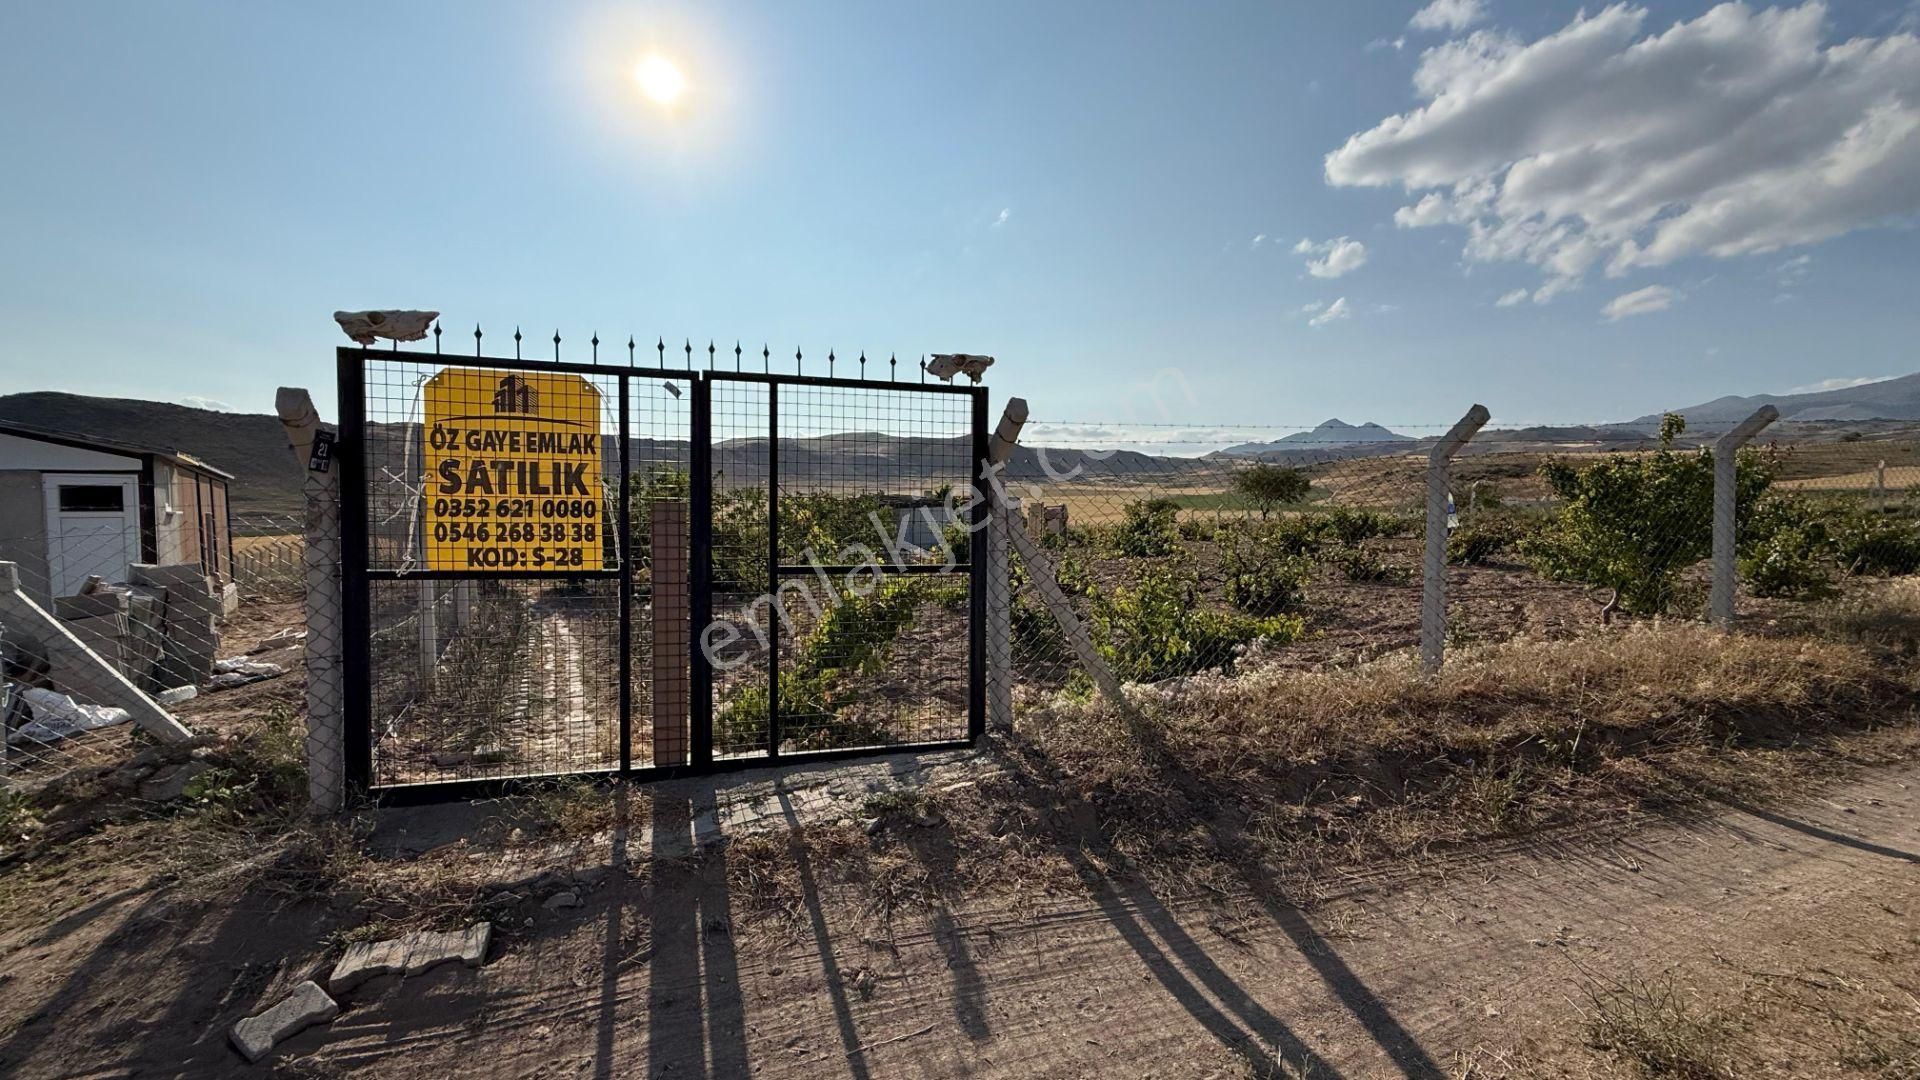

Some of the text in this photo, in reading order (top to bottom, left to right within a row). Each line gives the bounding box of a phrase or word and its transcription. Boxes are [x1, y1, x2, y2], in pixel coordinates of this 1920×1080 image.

[430, 423, 597, 455] ÖZ GAYE EMLAK
[317, 442, 328, 457] 21
[438, 459, 590, 495] SATILIK
[434, 498, 596, 518] 0352 621 0080
[434, 522, 596, 542] 0546 268 38 38
[467, 547, 583, 567] KOD: S-28
